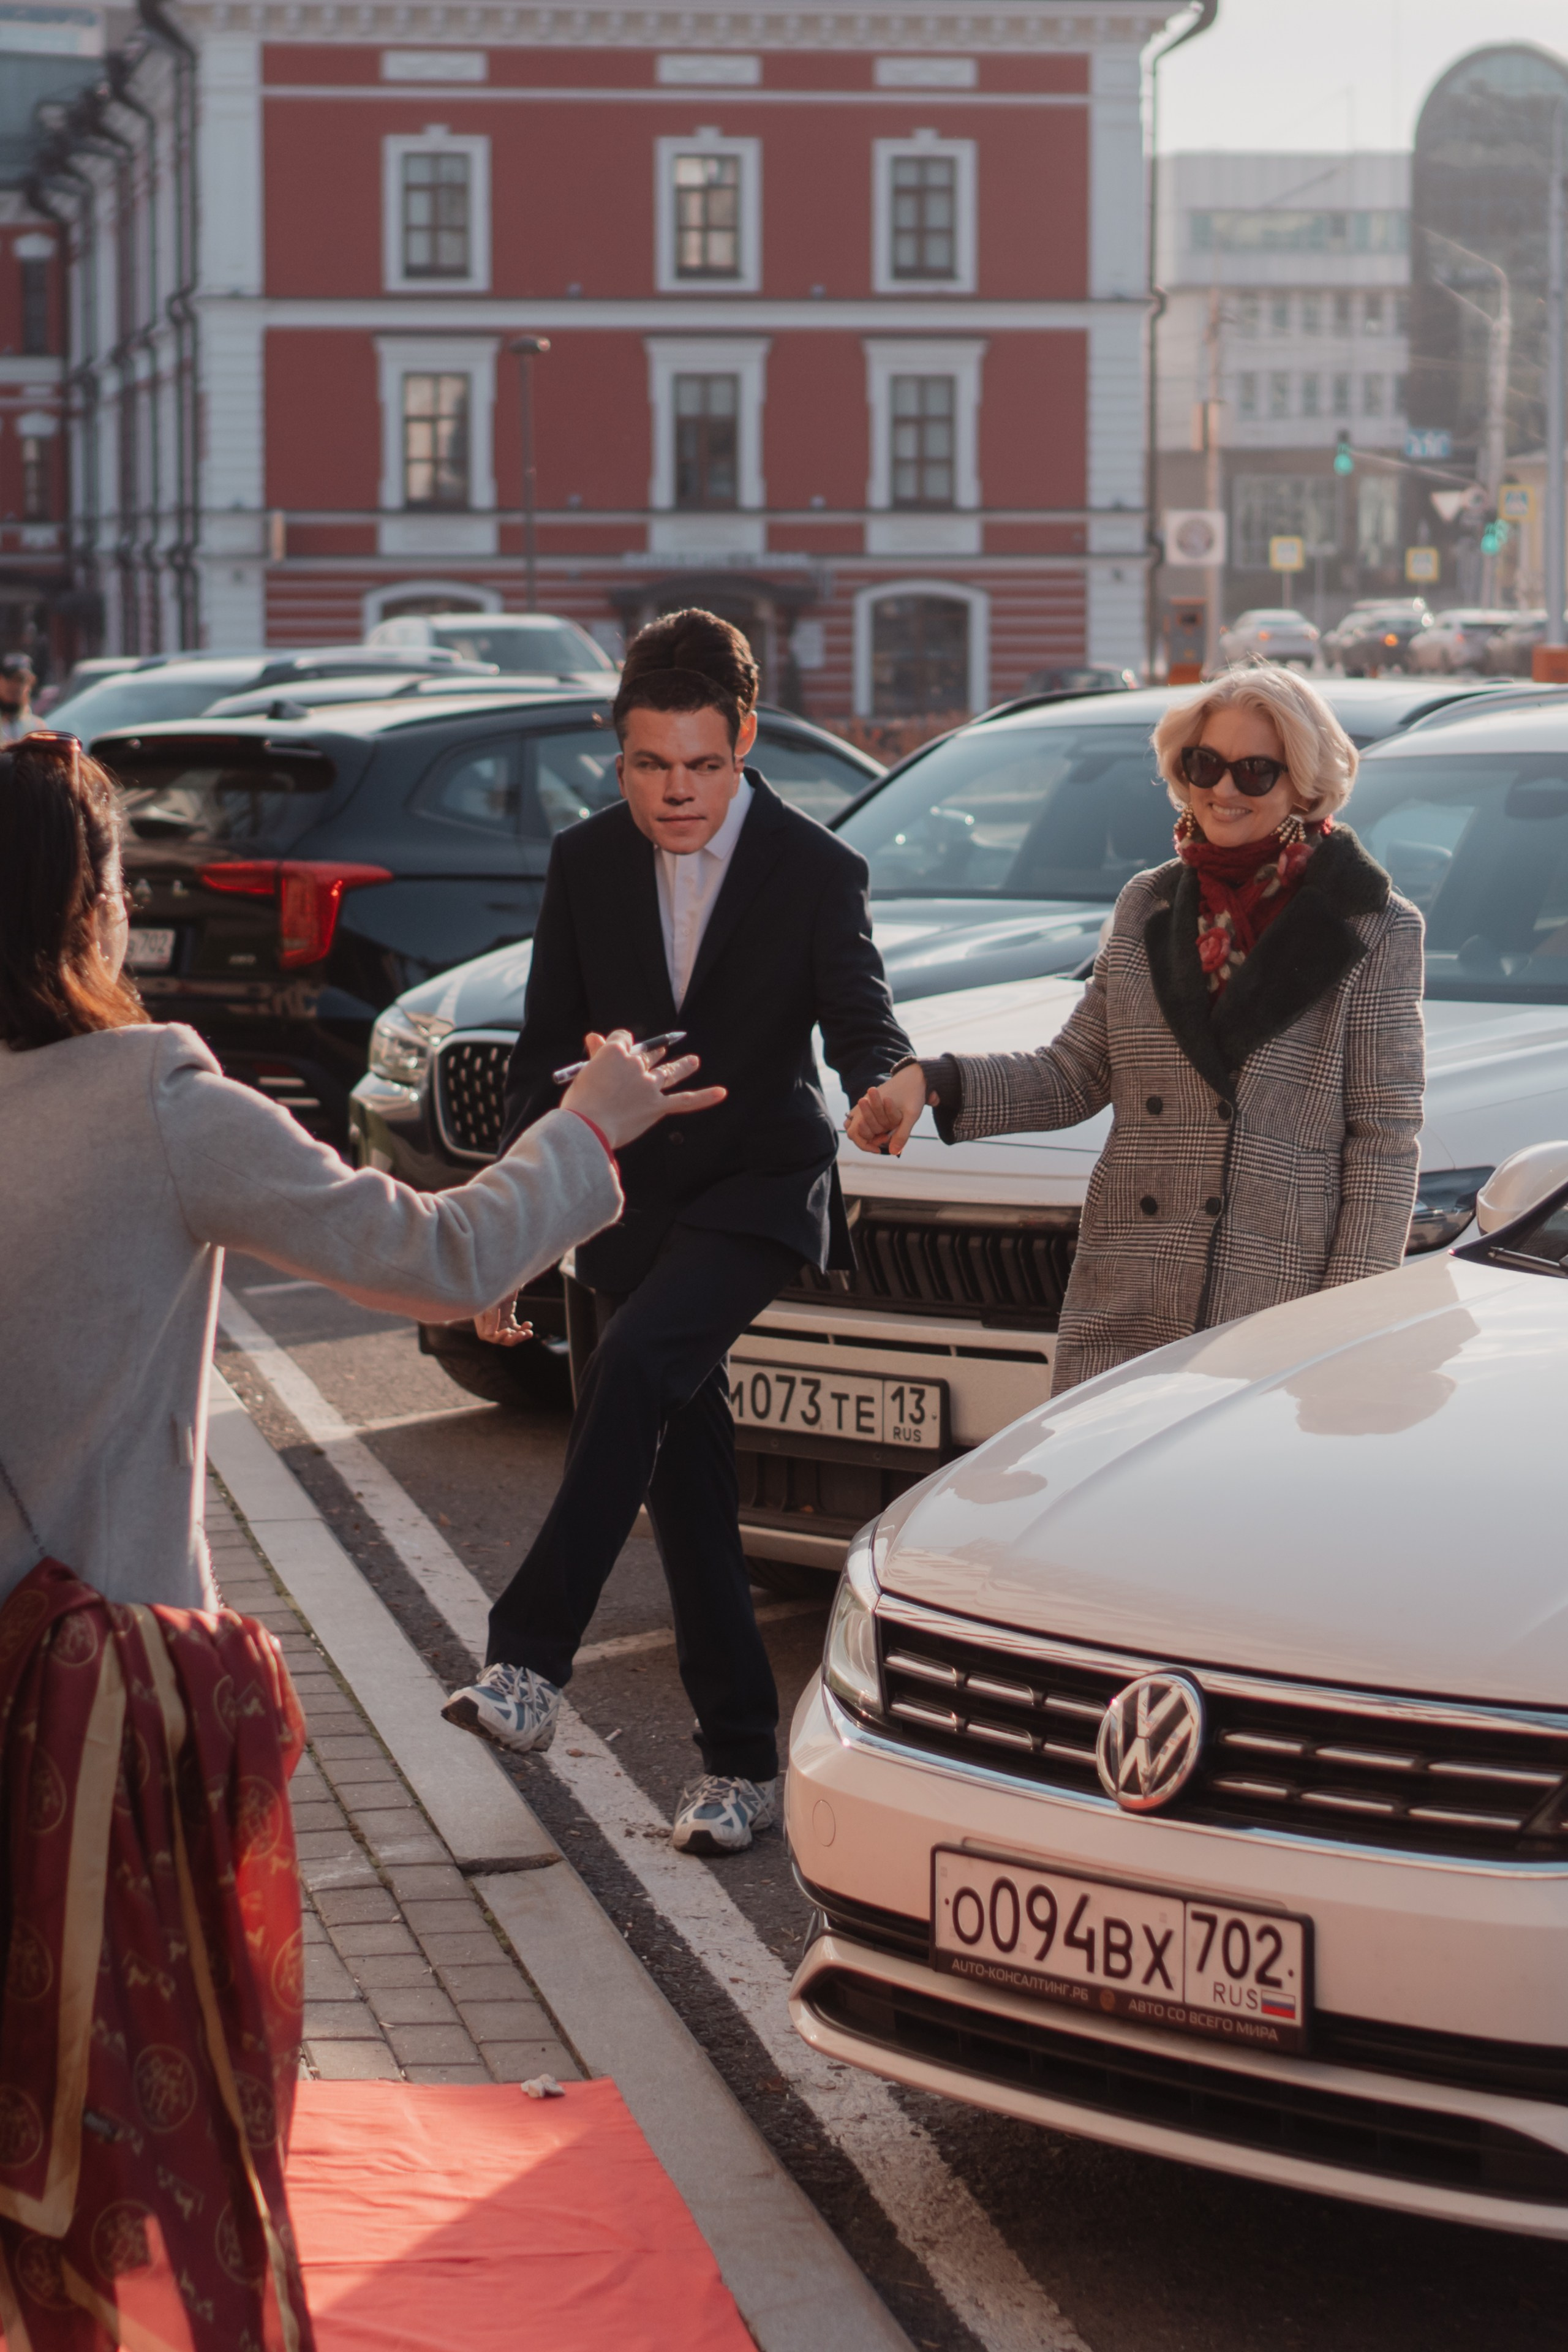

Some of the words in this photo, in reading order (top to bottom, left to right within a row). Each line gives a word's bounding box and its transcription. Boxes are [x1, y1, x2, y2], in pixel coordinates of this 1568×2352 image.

[891, 1385, 926, 1424] 13
[893, 1426, 922, 1442] RUS
[1191, 1910, 1283, 1988] 702
[1213, 1981, 1258, 2010] RUS
[1128, 1999, 1164, 2017] АВТО
[1167, 2007, 1186, 2022] СО
[1189, 2011, 1233, 2032] ВСЕГО
[1236, 2022, 1278, 2042] МИРА
